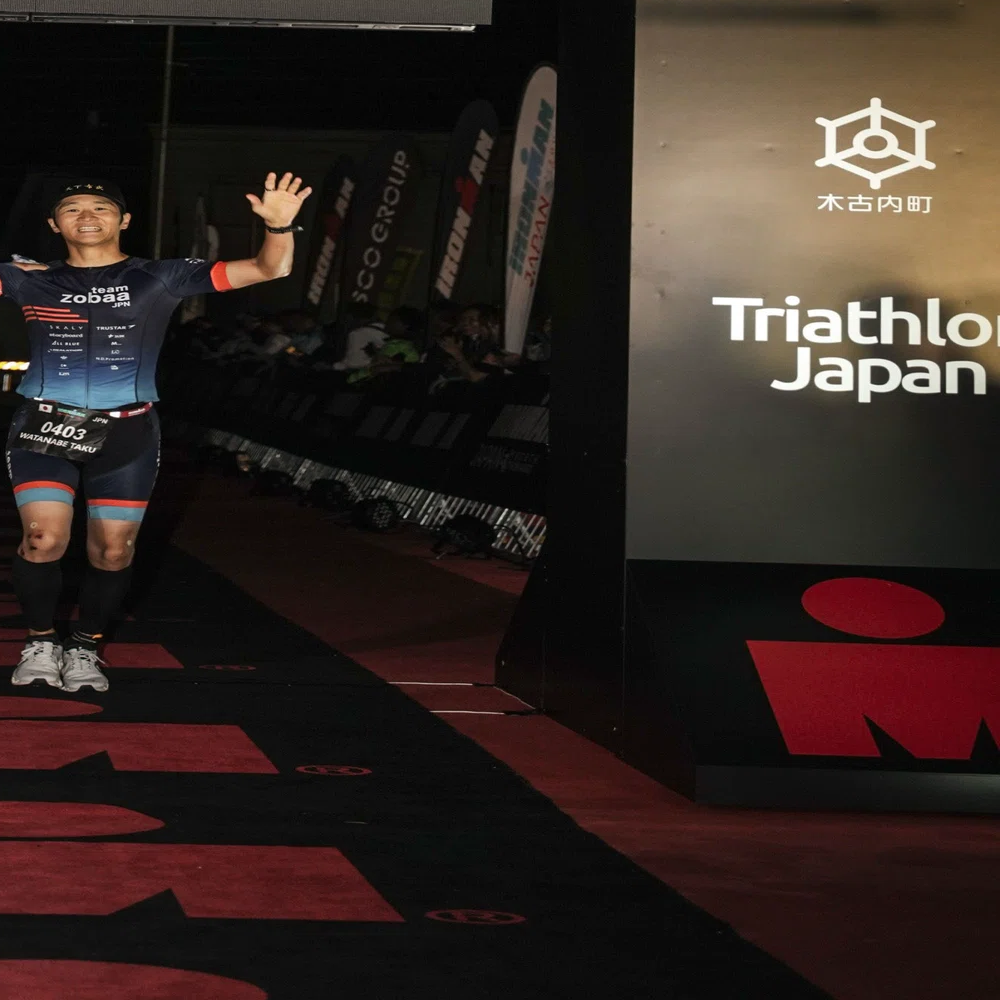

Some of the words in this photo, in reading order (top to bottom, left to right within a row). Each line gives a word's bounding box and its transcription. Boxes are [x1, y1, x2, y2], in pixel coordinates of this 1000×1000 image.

[370, 150, 411, 244] GROUP
[817, 193, 933, 213] 木古内町
[60, 291, 131, 304] zobaa
[91, 285, 129, 294] team
[712, 295, 1000, 347] Triathlo
[770, 347, 986, 403] Japan
[92, 416, 109, 425] JPN
[40, 421, 87, 441] 0403
[19, 431, 69, 448] WATANABE
[70, 441, 97, 455] TAKU
